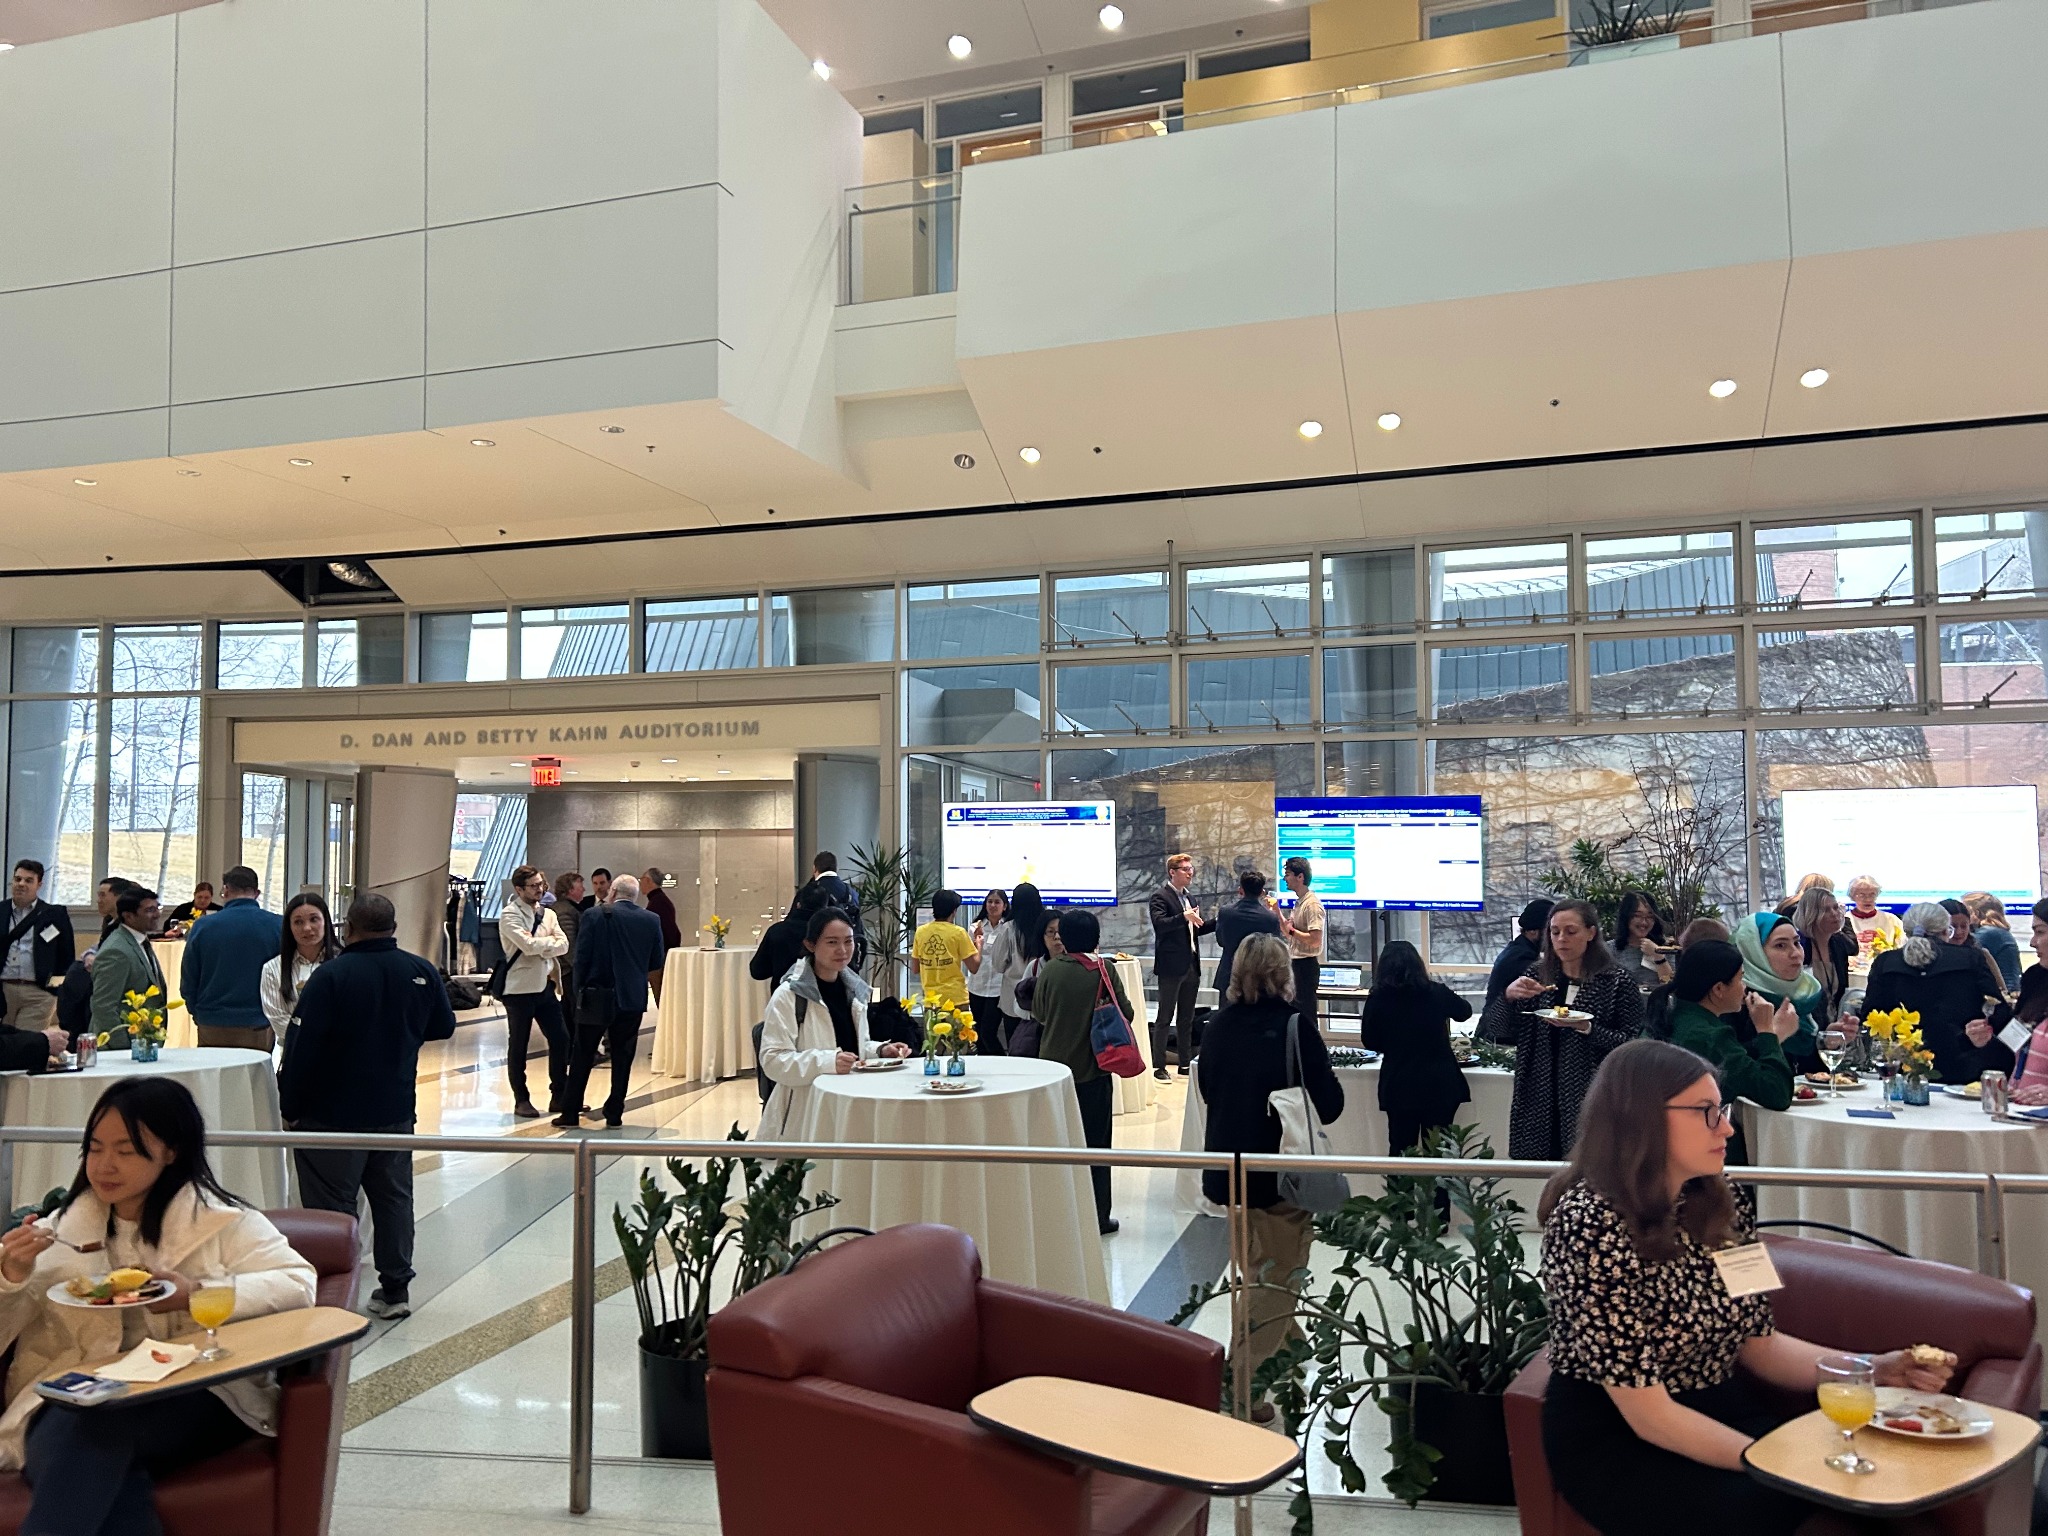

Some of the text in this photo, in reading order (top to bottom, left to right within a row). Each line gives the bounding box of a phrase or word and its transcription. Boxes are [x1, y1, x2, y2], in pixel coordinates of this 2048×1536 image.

[341, 720, 760, 748] D. DAN AND BETTY KAHN AUDITORIUM
